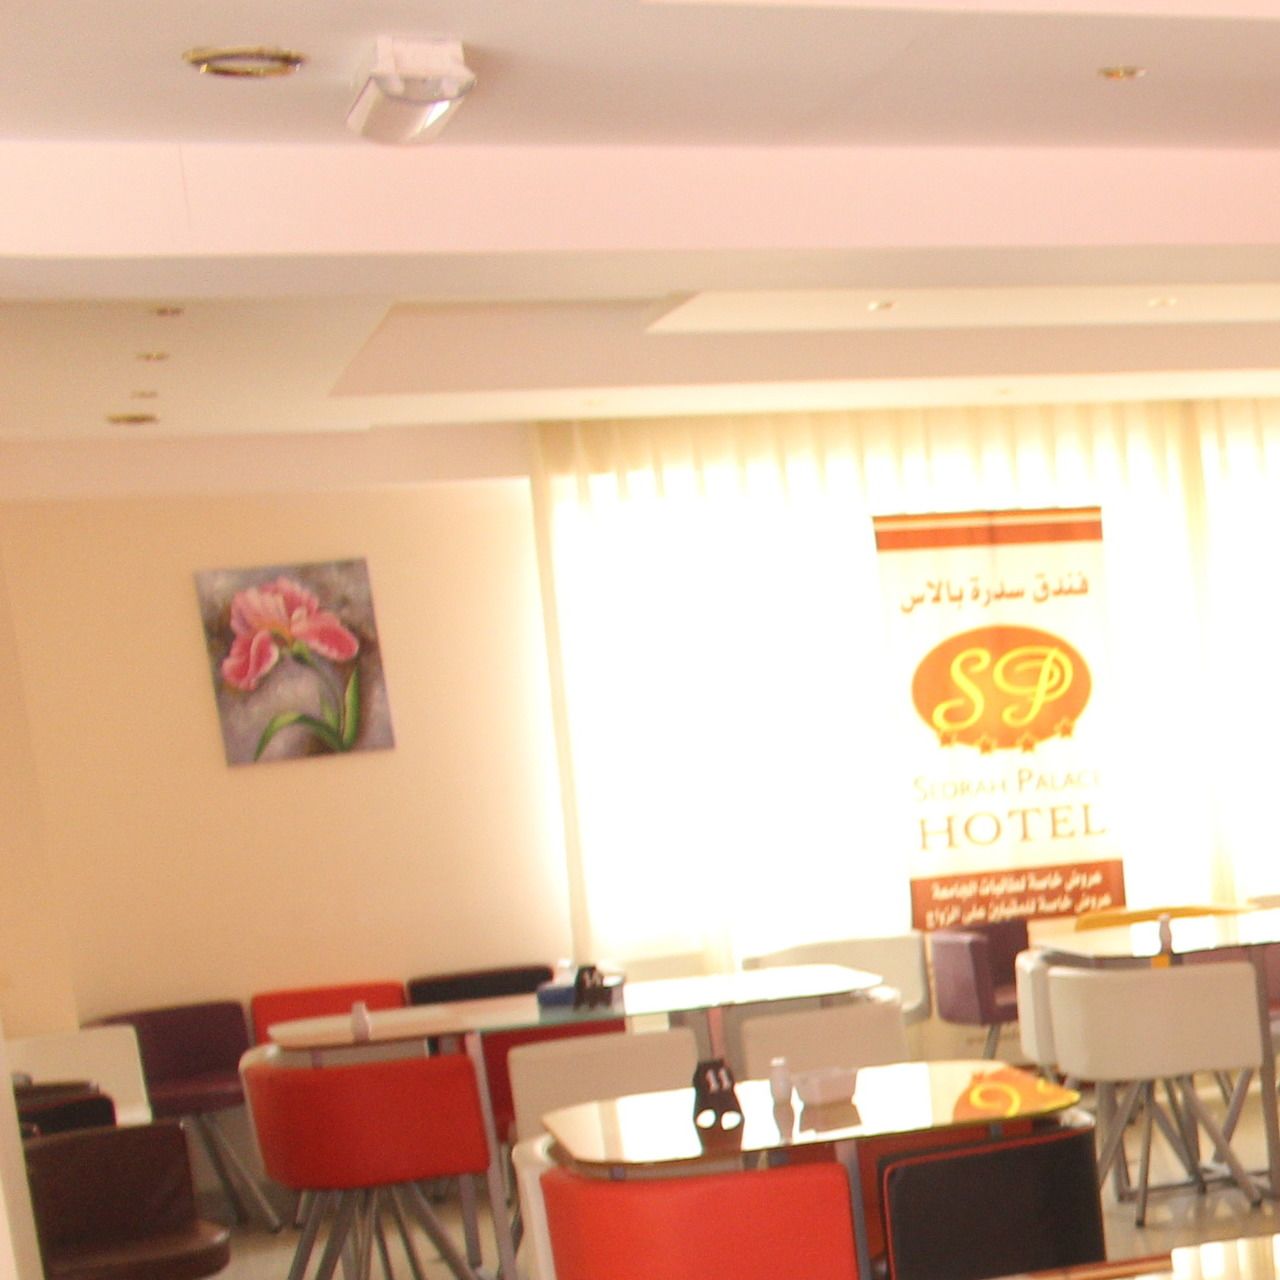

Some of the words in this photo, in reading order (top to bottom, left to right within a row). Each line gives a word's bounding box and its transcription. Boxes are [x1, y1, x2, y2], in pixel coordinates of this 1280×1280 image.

[900, 579, 964, 614] بالاس
[970, 575, 1025, 607] سدرة
[1033, 571, 1089, 604] فندق
[918, 802, 1110, 851] HOTEL
